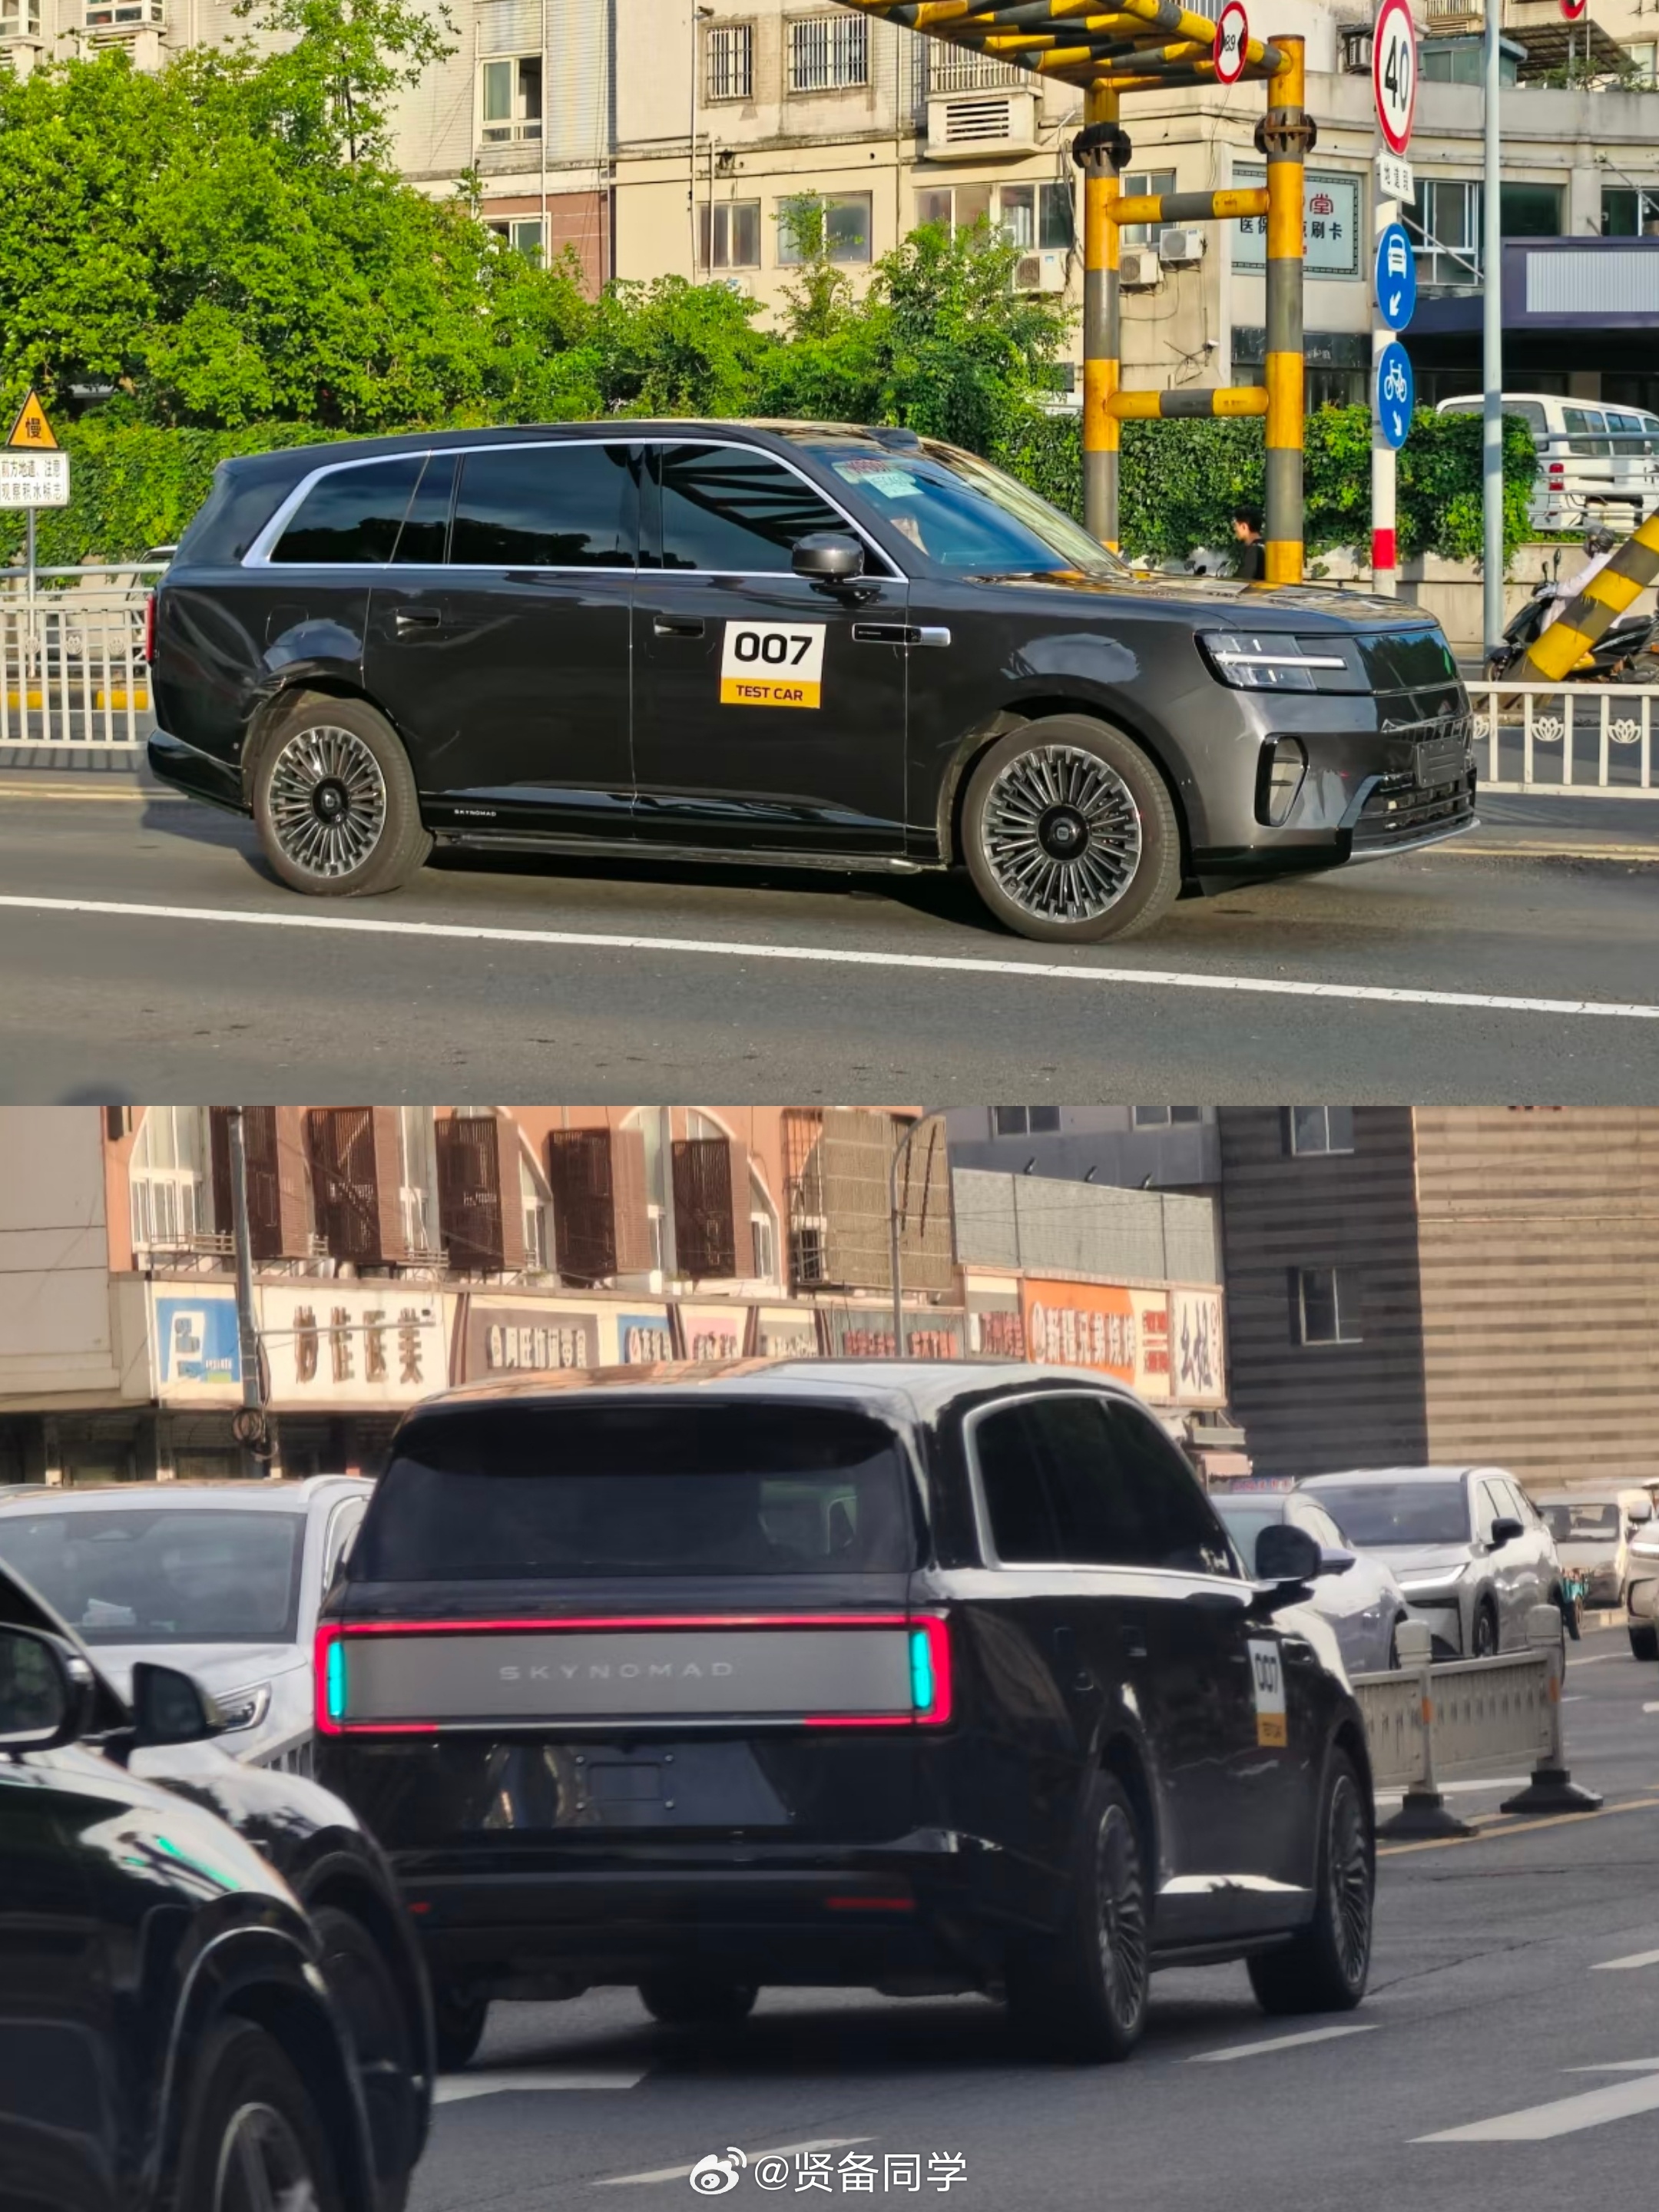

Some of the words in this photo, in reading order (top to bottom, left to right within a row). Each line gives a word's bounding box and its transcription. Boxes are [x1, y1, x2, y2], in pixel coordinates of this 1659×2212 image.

[1385, 35, 1409, 112] 40
[1240, 217, 1343, 240] 医保刷卡
[25, 417, 41, 439] 慢
[2, 482, 62, 500] 观察积水标志
[734, 631, 813, 665] 007
[736, 684, 770, 698] TEST
[773, 688, 803, 701] CAR
[500, 1662, 733, 1681] SKYNOMAD
